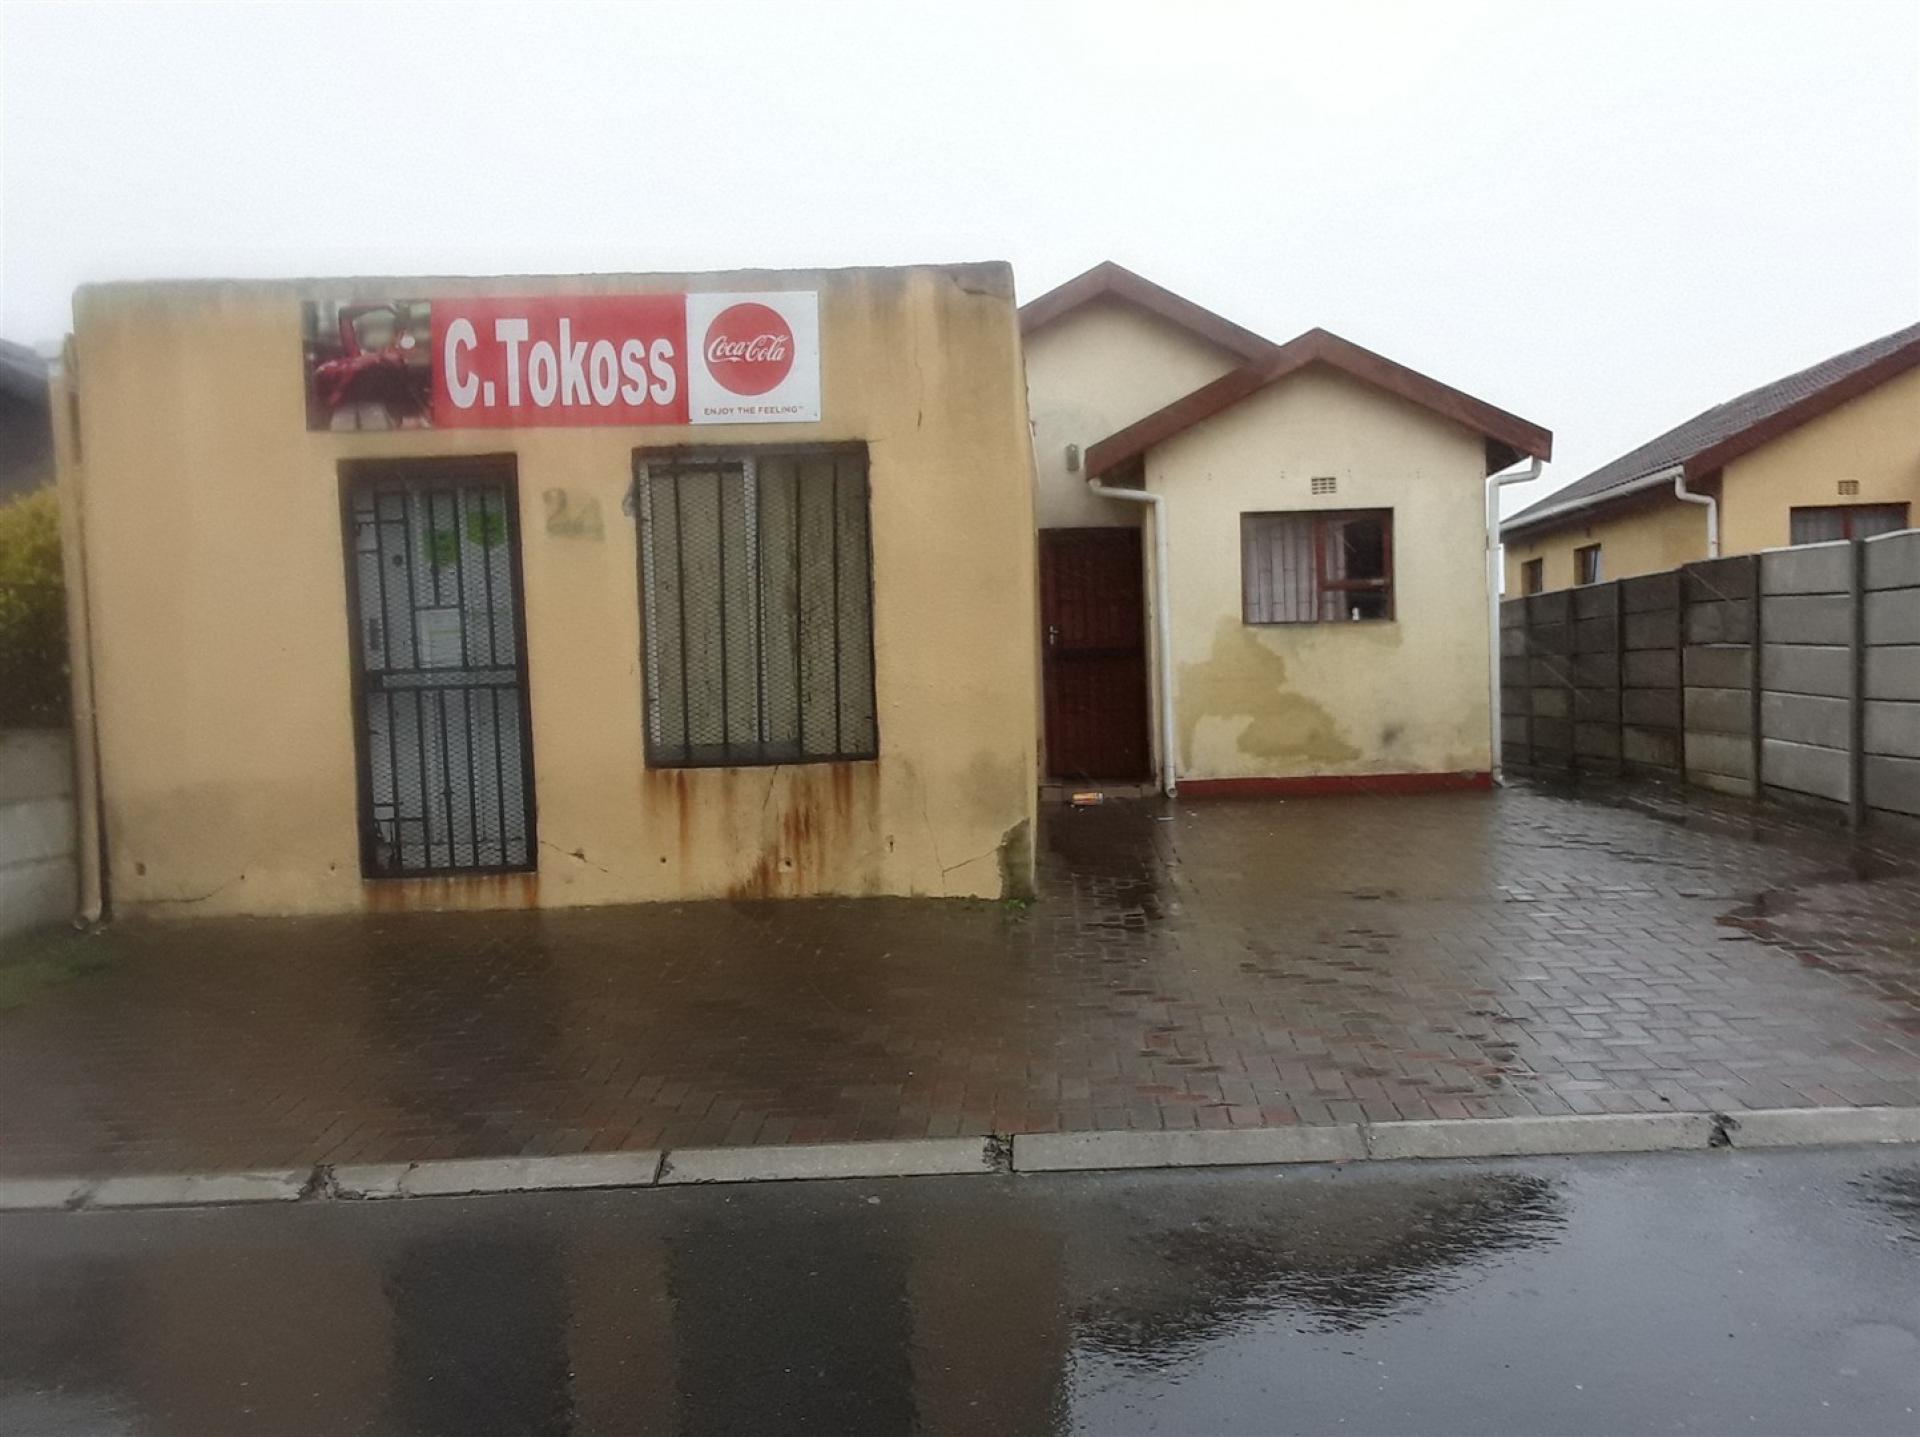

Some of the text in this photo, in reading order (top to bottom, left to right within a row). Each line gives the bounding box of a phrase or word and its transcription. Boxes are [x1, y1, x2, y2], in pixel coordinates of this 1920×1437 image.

[444, 317, 677, 409] C.Tokoss
[704, 405, 798, 416] ENJOY THE FEELING
